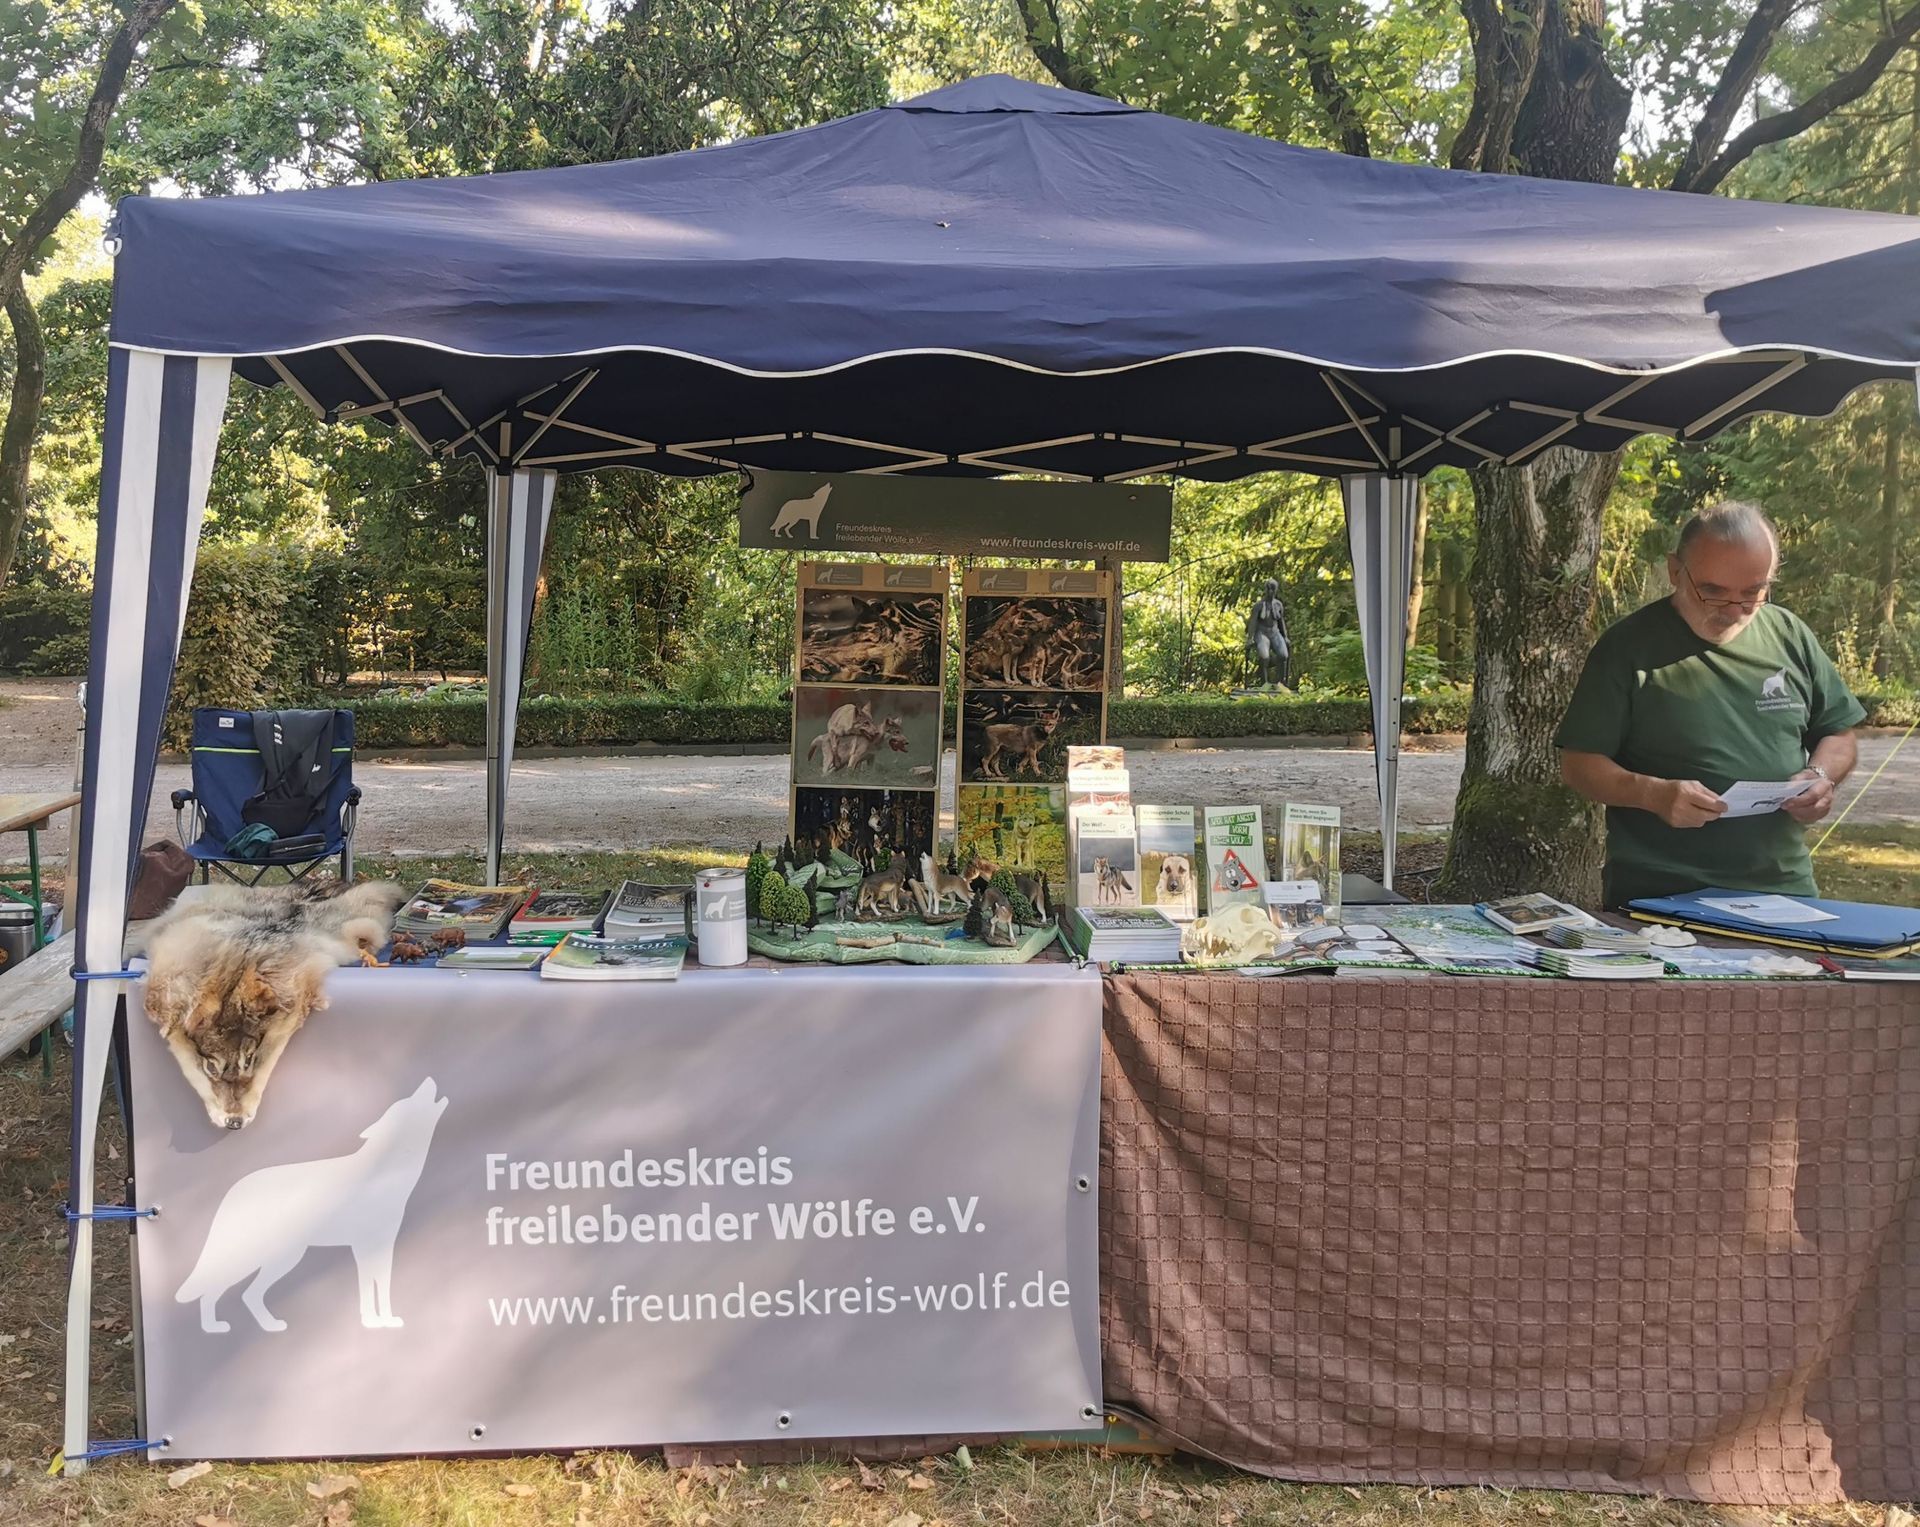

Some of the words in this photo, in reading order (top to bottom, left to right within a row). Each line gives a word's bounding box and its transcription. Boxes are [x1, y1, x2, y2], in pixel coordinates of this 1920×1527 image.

[835, 533, 882, 543] freilebender
[836, 522, 892, 533] Freundeskreis
[980, 537, 1141, 551] www.freundeskreis-wolf.de
[485, 1145, 794, 1191] Freundeskreis
[485, 1202, 759, 1246] freilebender
[767, 1198, 896, 1241] Wölfe
[908, 1195, 986, 1235] e.V.
[488, 1270, 1071, 1326] www.freundeskreis-wolf.de
